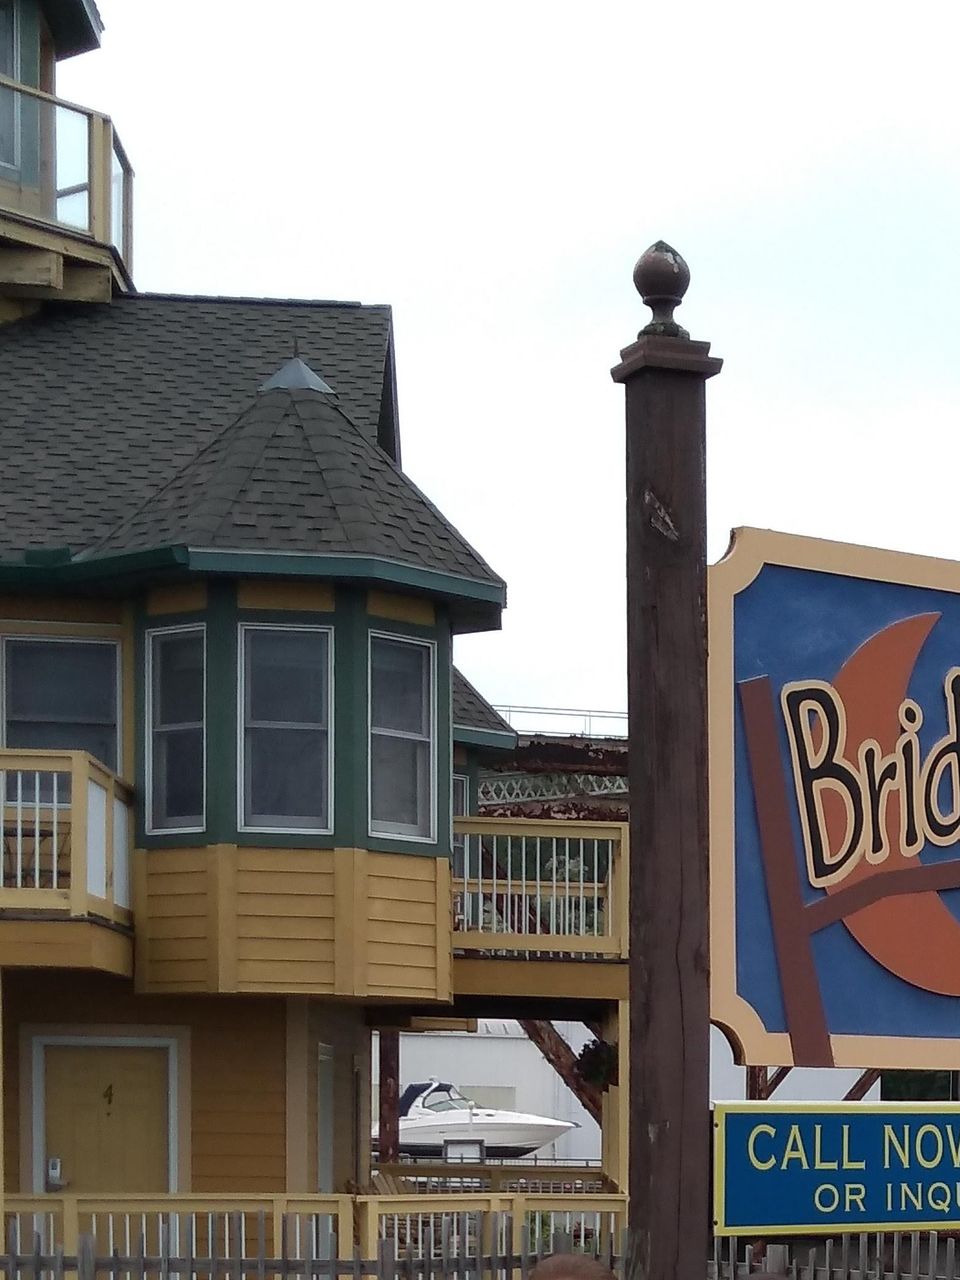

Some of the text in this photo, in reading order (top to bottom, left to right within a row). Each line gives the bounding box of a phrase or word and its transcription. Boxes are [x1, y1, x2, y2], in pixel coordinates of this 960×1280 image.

[103, 1084, 113, 1104] 4
[748, 1124, 866, 1171] CALL
[814, 1183, 866, 1213] OR
